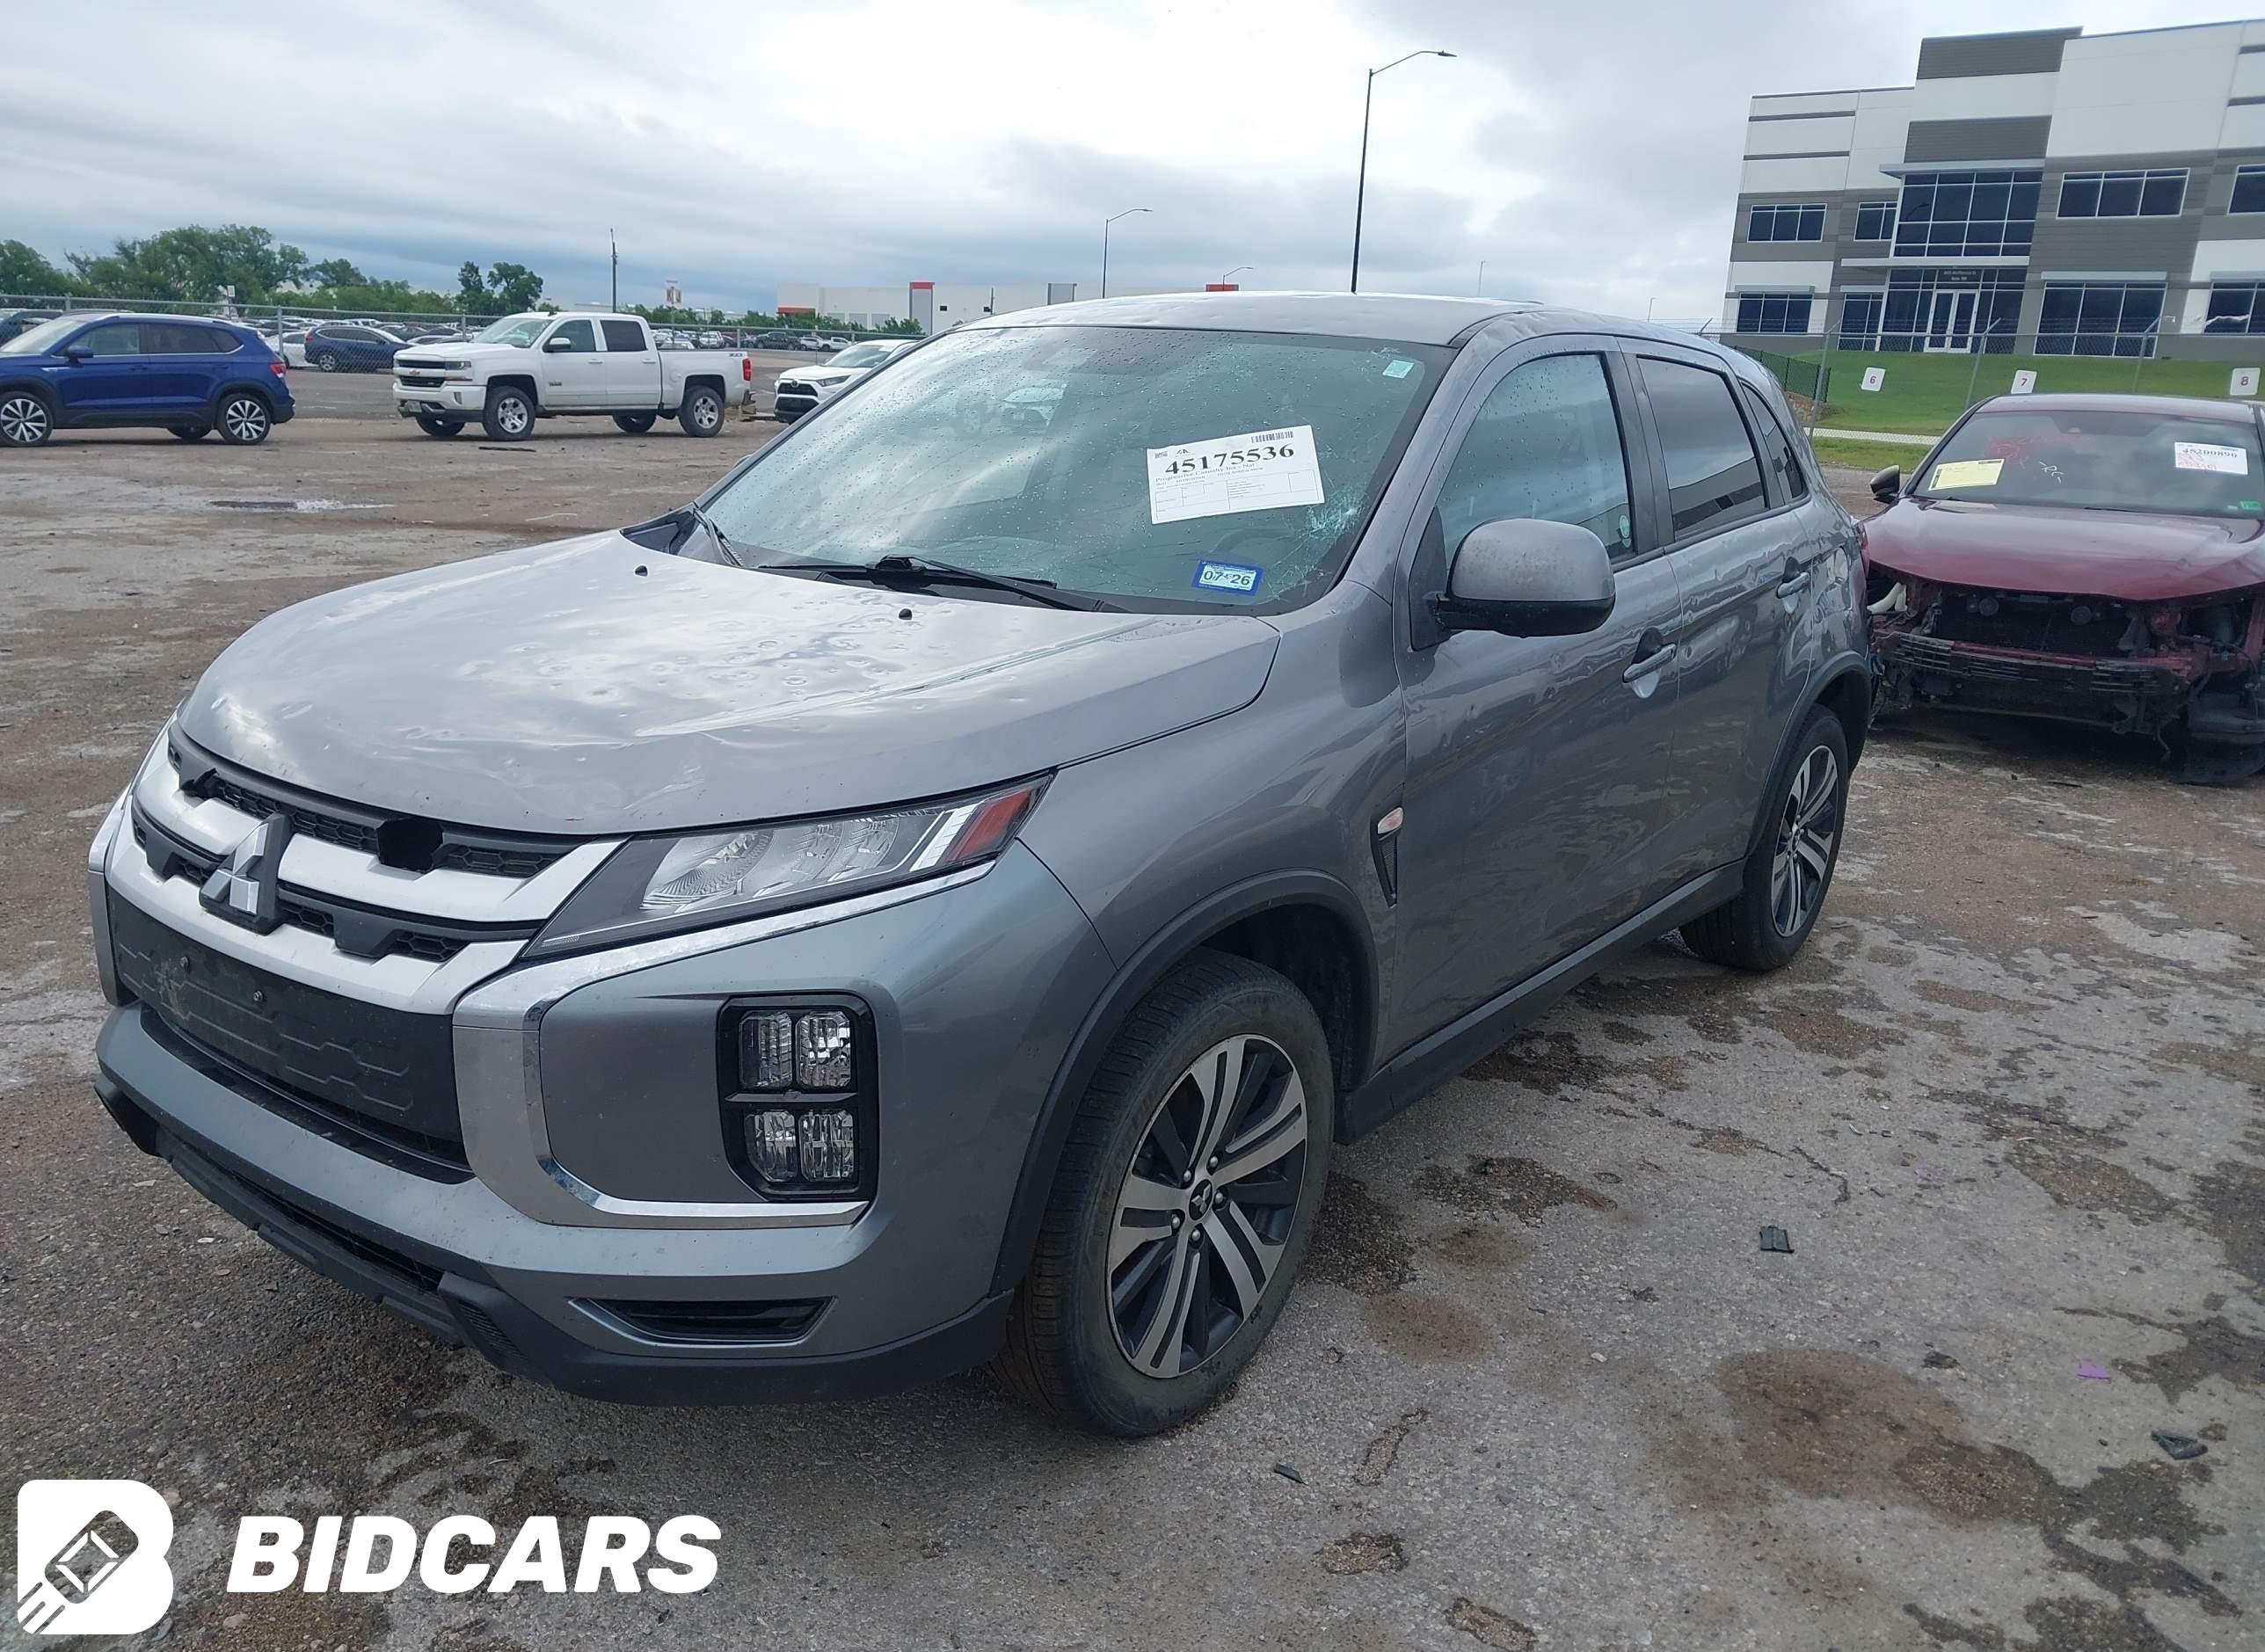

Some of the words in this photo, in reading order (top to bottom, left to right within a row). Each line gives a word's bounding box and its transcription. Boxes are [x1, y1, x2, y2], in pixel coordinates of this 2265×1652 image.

[1868, 375, 1877, 384] 6
[2020, 377, 2028, 386] 7
[2240, 375, 2249, 386] 8
[1165, 443, 1294, 474] 45175536
[1204, 570, 1224, 581] 07
[1230, 574, 1251, 586] 26
